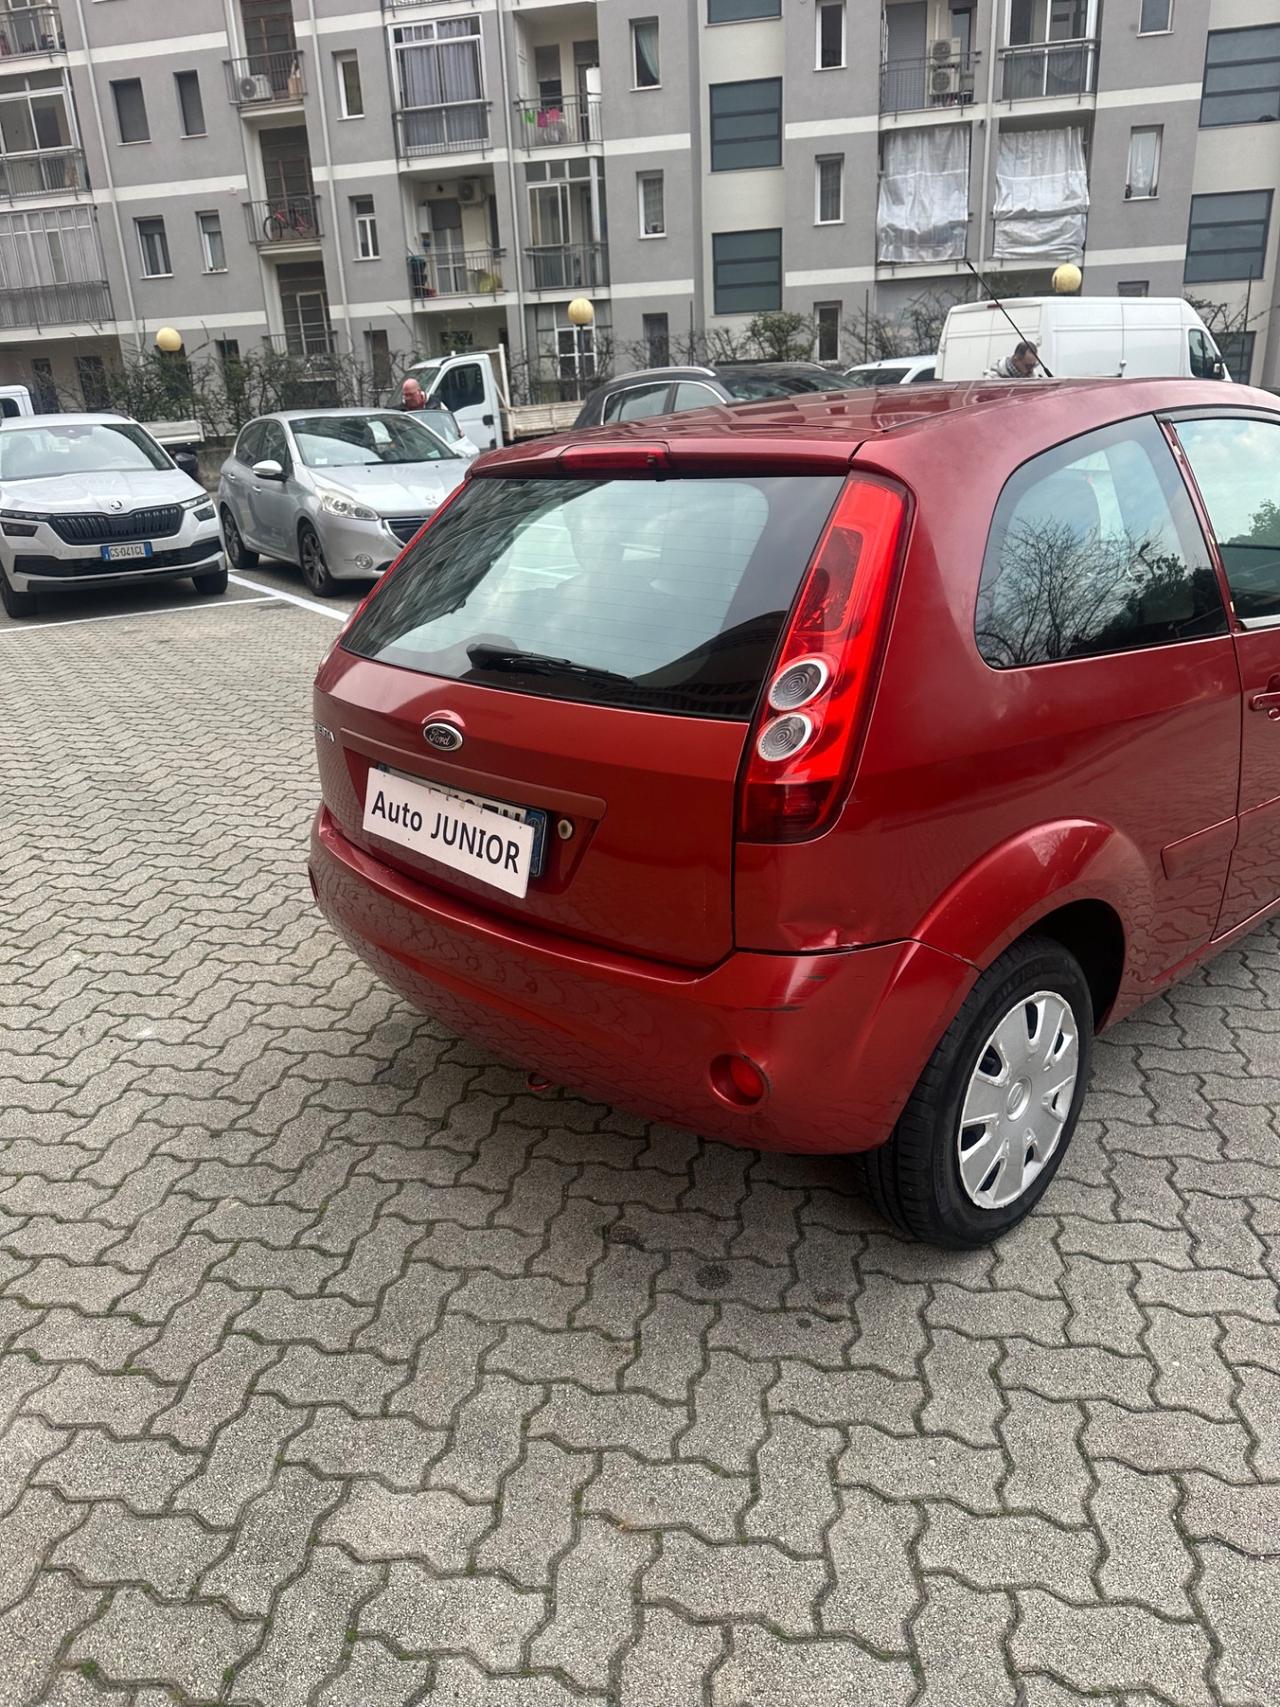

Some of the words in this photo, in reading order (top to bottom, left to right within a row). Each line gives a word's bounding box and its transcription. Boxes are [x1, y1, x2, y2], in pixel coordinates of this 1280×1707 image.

[430, 727, 451, 746] Ford
[371, 790, 422, 832] Auto
[430, 812, 520, 874] JUNIOR
